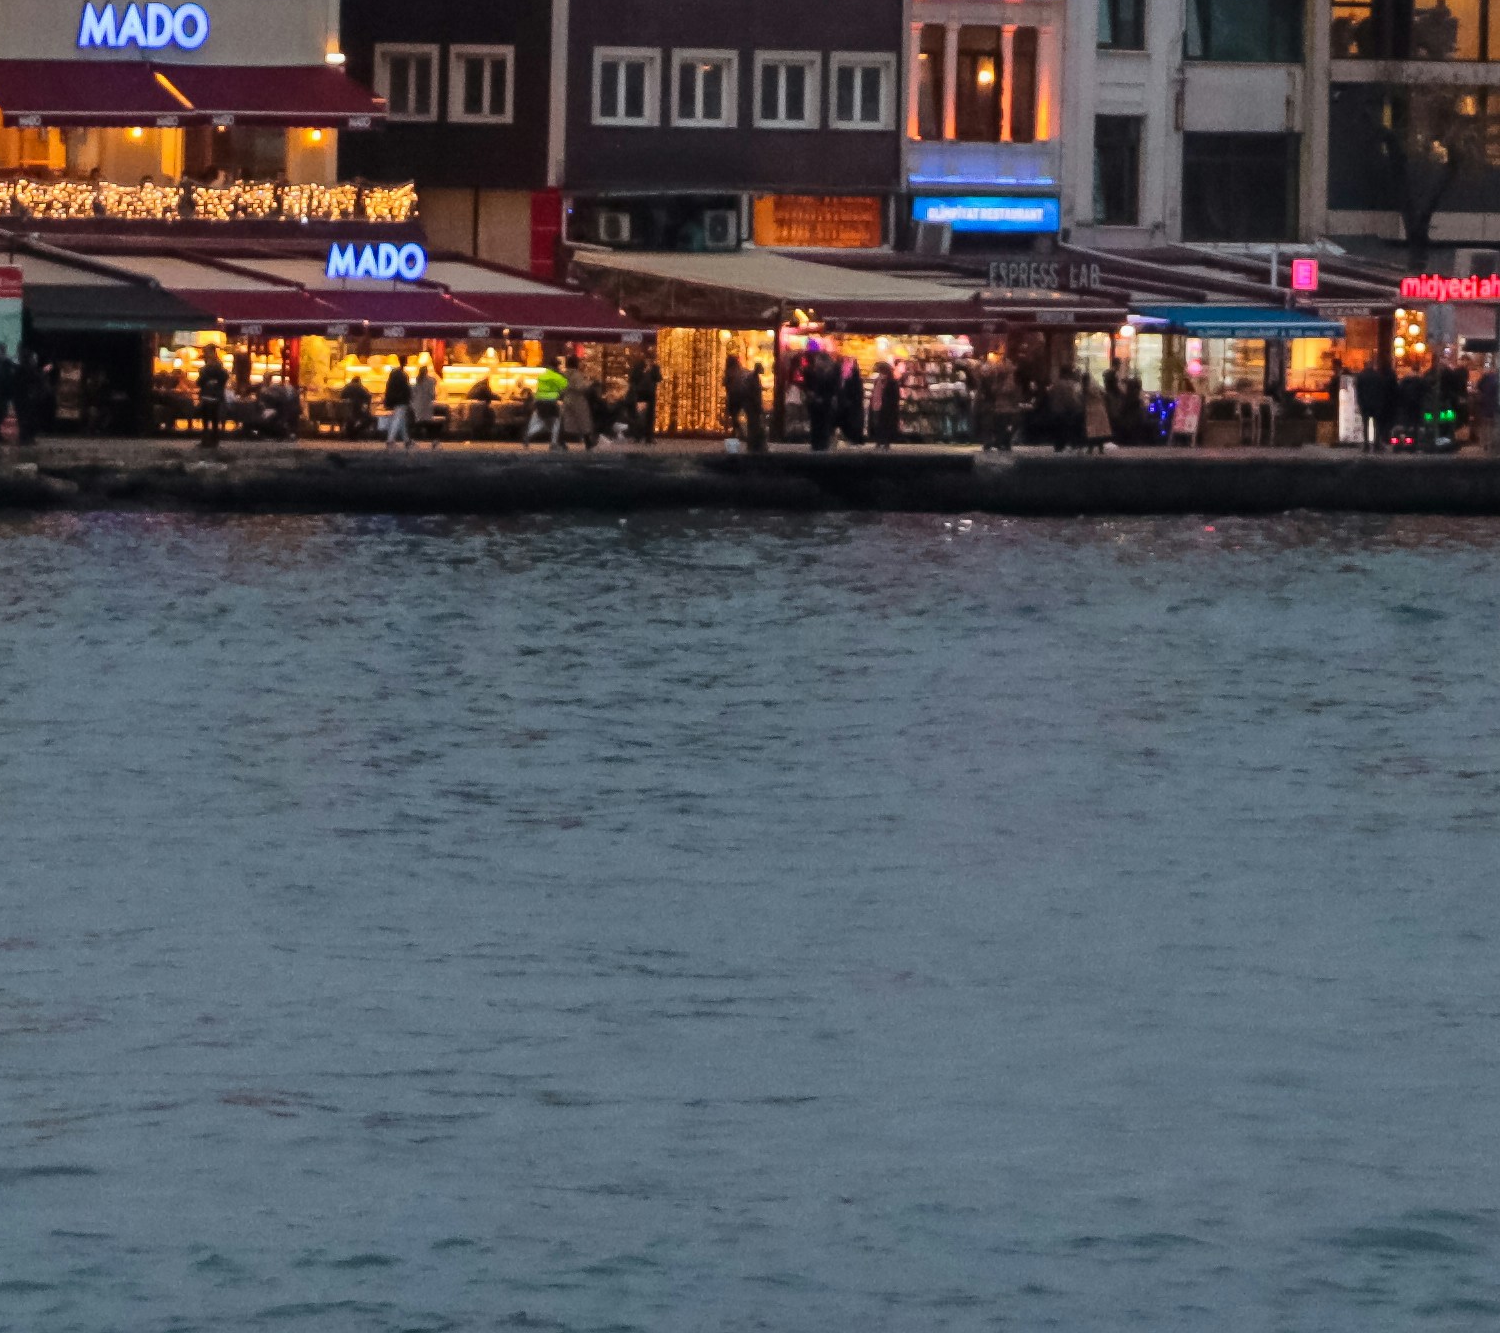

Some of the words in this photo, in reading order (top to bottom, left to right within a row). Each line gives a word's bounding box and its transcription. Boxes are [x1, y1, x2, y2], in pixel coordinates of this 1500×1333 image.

[78, 1, 209, 51] MADO
[325, 241, 427, 282] MADO
[1400, 273, 1477, 301] midyeci
